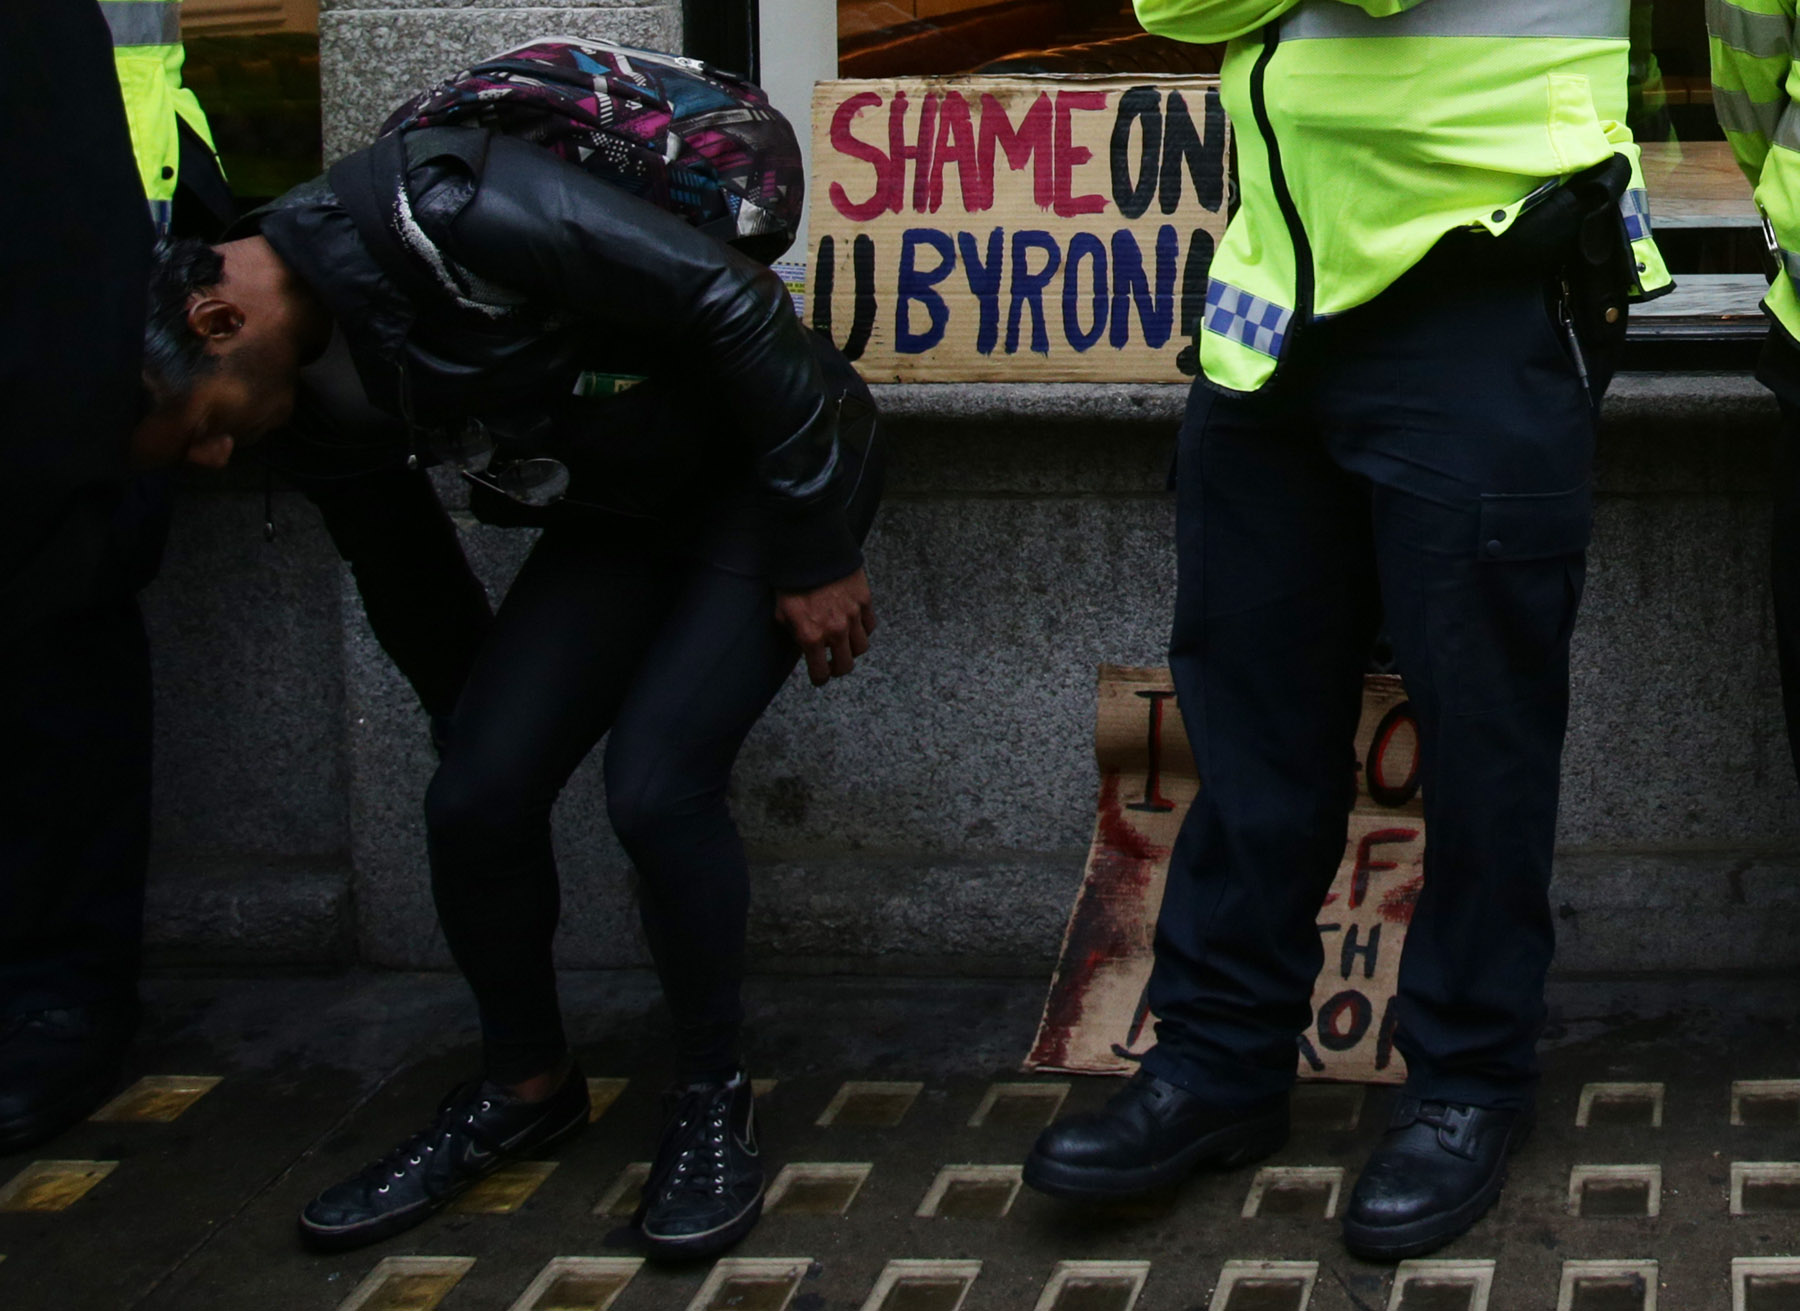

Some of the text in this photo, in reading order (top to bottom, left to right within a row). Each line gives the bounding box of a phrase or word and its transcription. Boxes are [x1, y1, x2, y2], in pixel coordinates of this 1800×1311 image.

[829, 85, 1226, 222] SHAME ON
[812, 234, 877, 363] U
